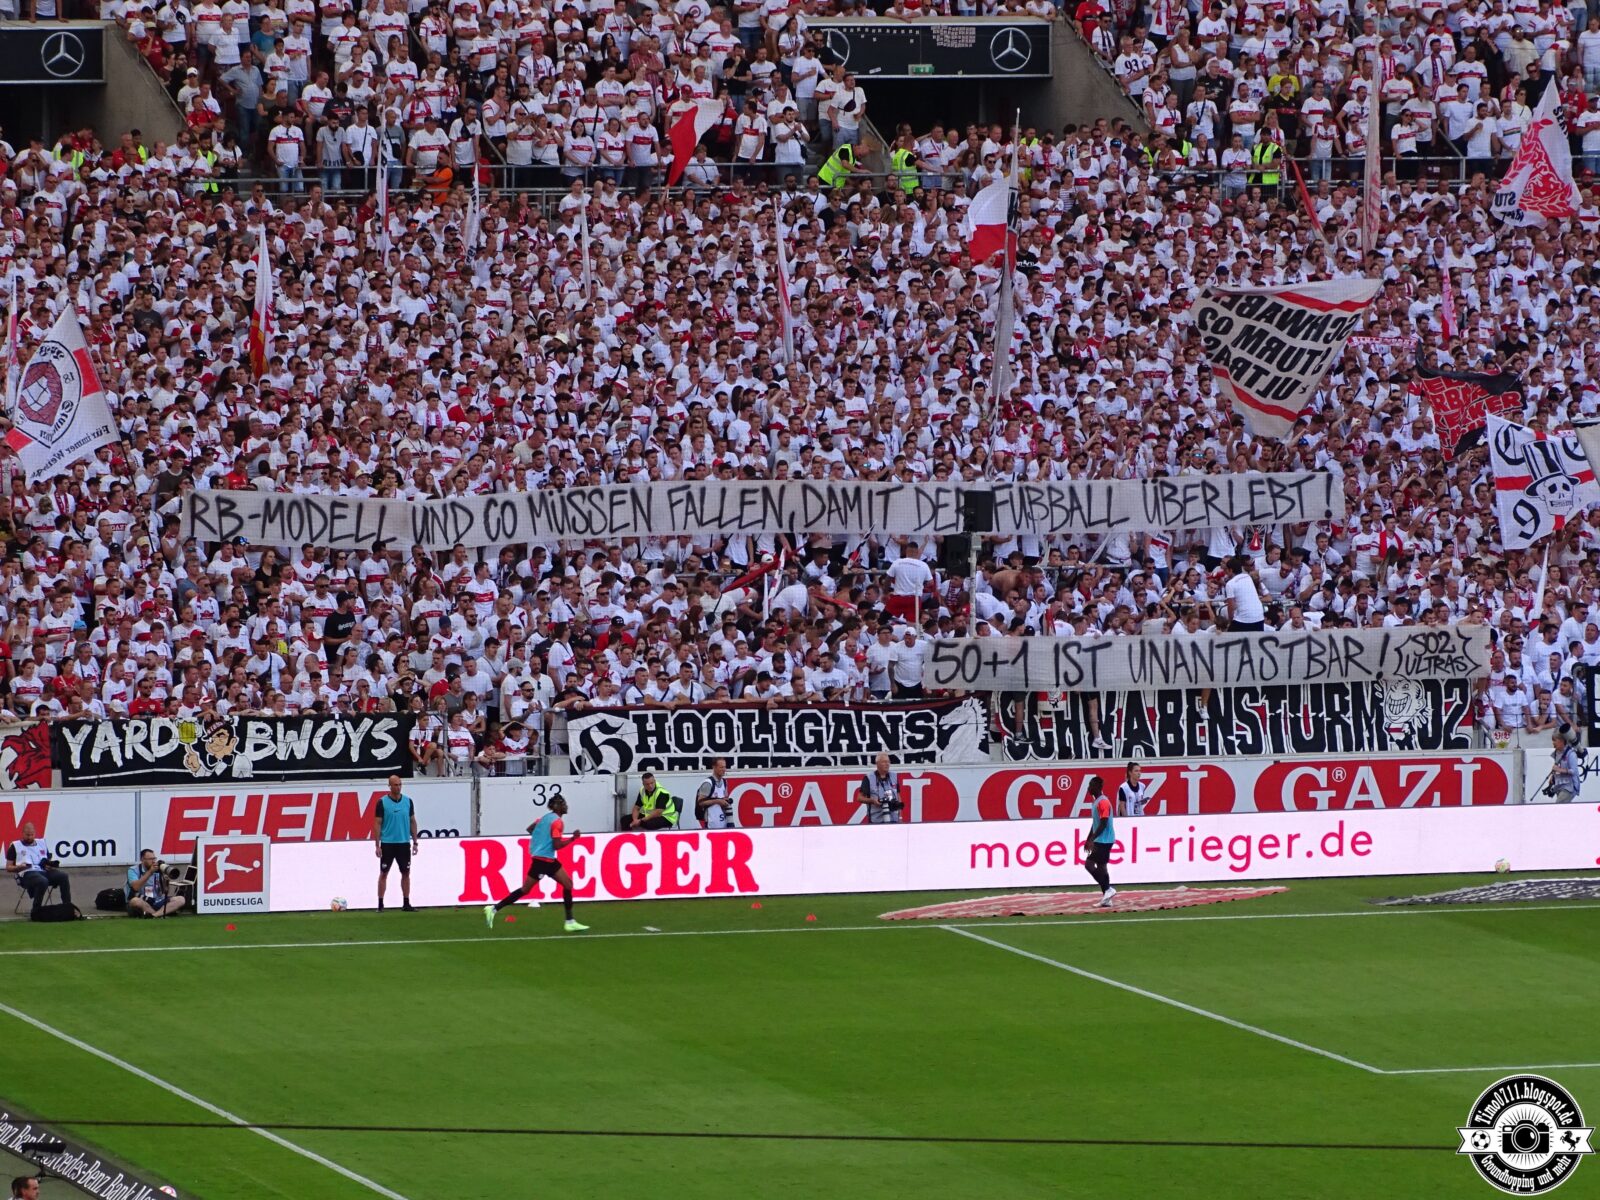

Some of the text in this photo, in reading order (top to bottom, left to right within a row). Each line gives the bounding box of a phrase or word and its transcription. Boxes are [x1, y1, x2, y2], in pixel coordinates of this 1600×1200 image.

[189, 492, 398, 545] RB-MODELL
[411, 503, 475, 546] UND
[482, 498, 518, 542] CO
[526, 488, 652, 537] MÜSSEN
[802, 484, 904, 530] DAMIT
[930, 639, 1030, 689] 50+1
[1054, 640, 1113, 689] IST
[1404, 650, 1469, 677] ULTRAS
[61, 717, 180, 770] YARD
[245, 716, 399, 763] BWOYS
[632, 708, 940, 755] HOOLIGANS
[970, 820, 1373, 873] moebel-rieger.de
[203, 896, 264, 907] BUNDESLIGA
